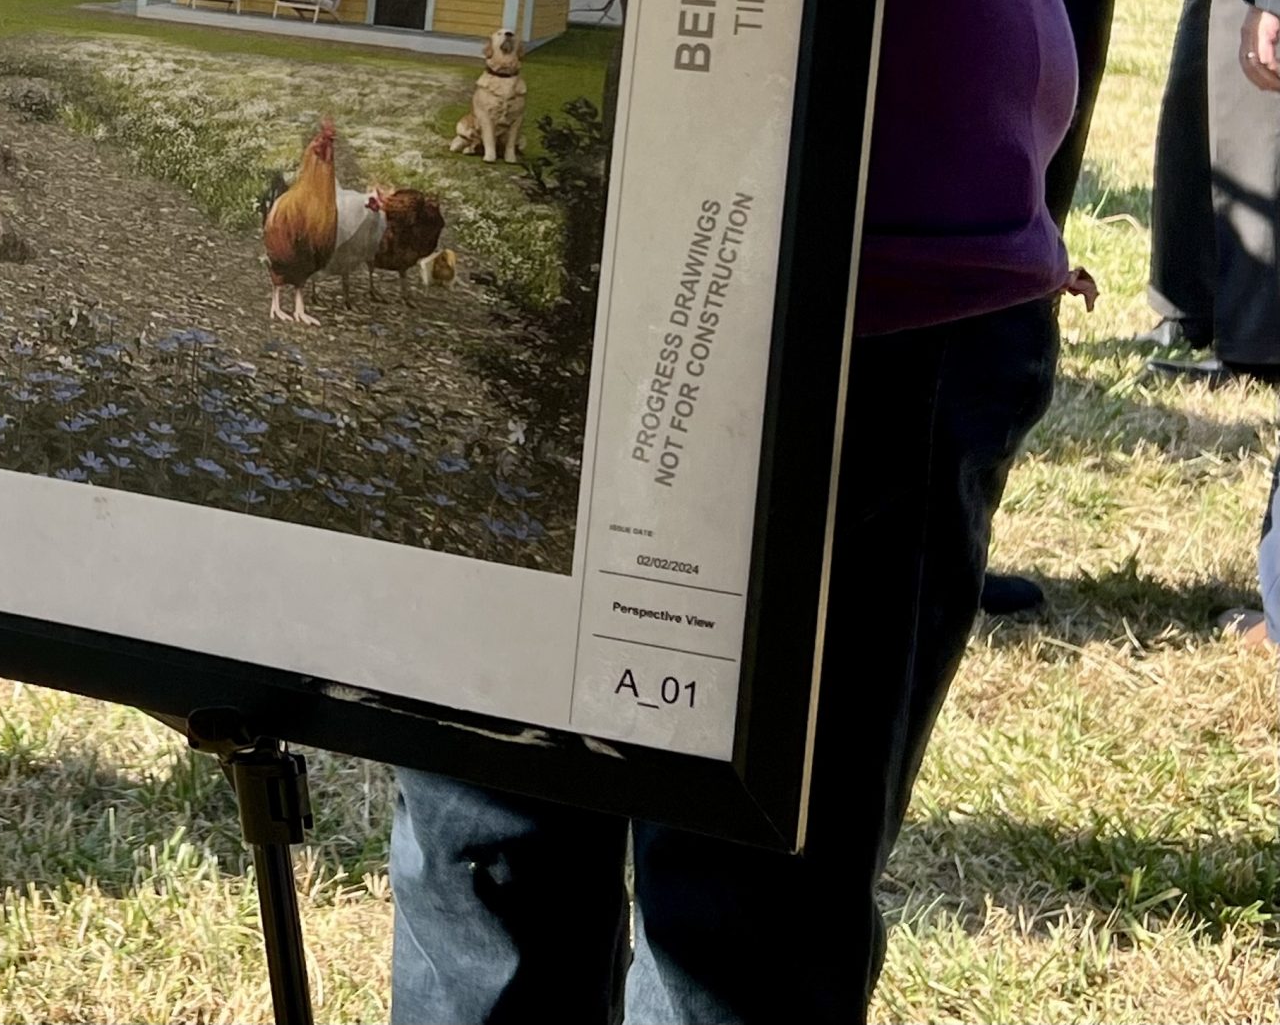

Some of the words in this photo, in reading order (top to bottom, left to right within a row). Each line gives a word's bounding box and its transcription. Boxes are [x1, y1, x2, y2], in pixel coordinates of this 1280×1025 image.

[632, 332, 684, 463] PROGRESS
[669, 199, 722, 328] DRAWINGS
[654, 436, 684, 487] NOT
[669, 383, 701, 433] FOR
[685, 192, 754, 378] CONSTRUCTION
[636, 554, 700, 575] 02/02/2024
[612, 601, 682, 624] Perspective
[685, 614, 716, 629] View
[614, 668, 697, 710] A_01
